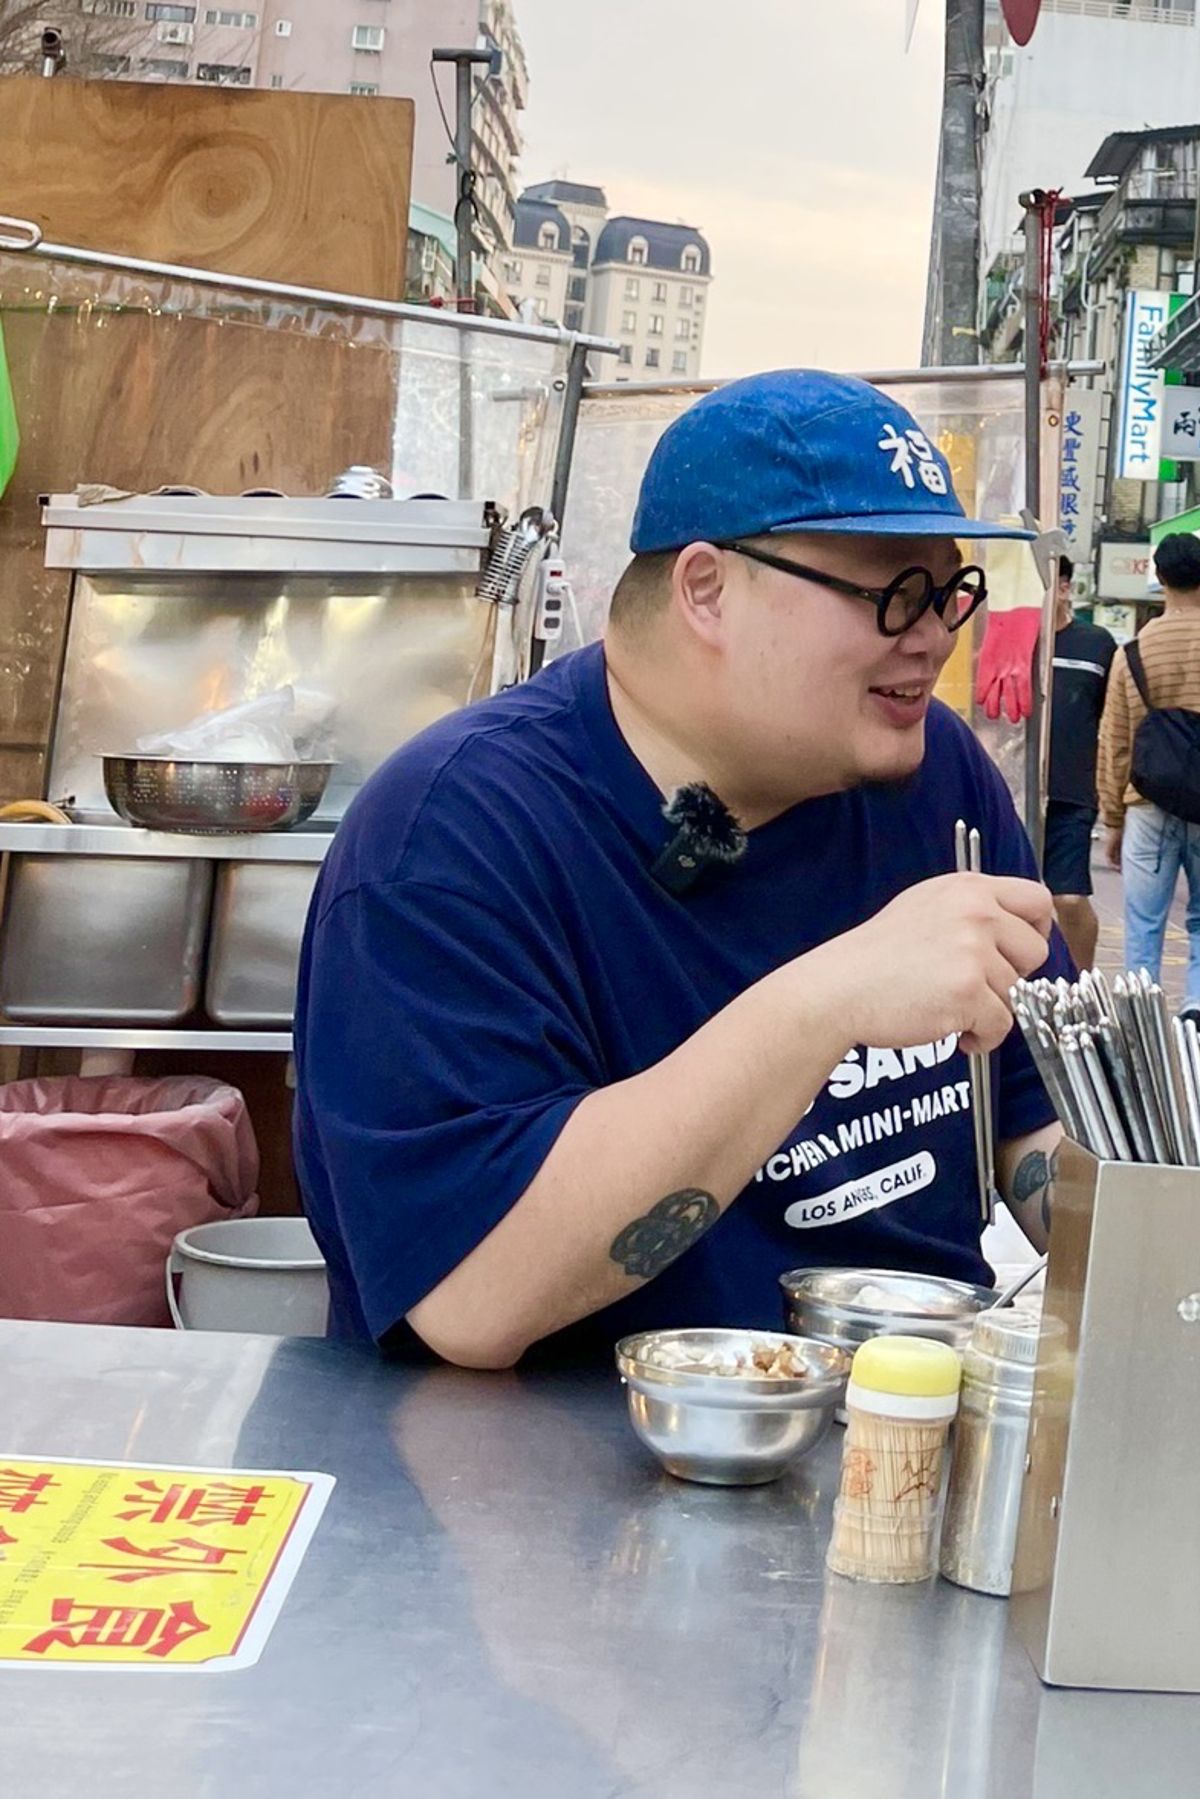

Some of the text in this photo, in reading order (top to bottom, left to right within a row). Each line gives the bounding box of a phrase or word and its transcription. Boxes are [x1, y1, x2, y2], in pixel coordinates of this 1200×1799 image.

[878, 423, 948, 495] 福
[837, 1081, 971, 1153] MINI-MART
[801, 1204, 837, 1223] LOS
[21, 1480, 275, 1657] 禁外食
